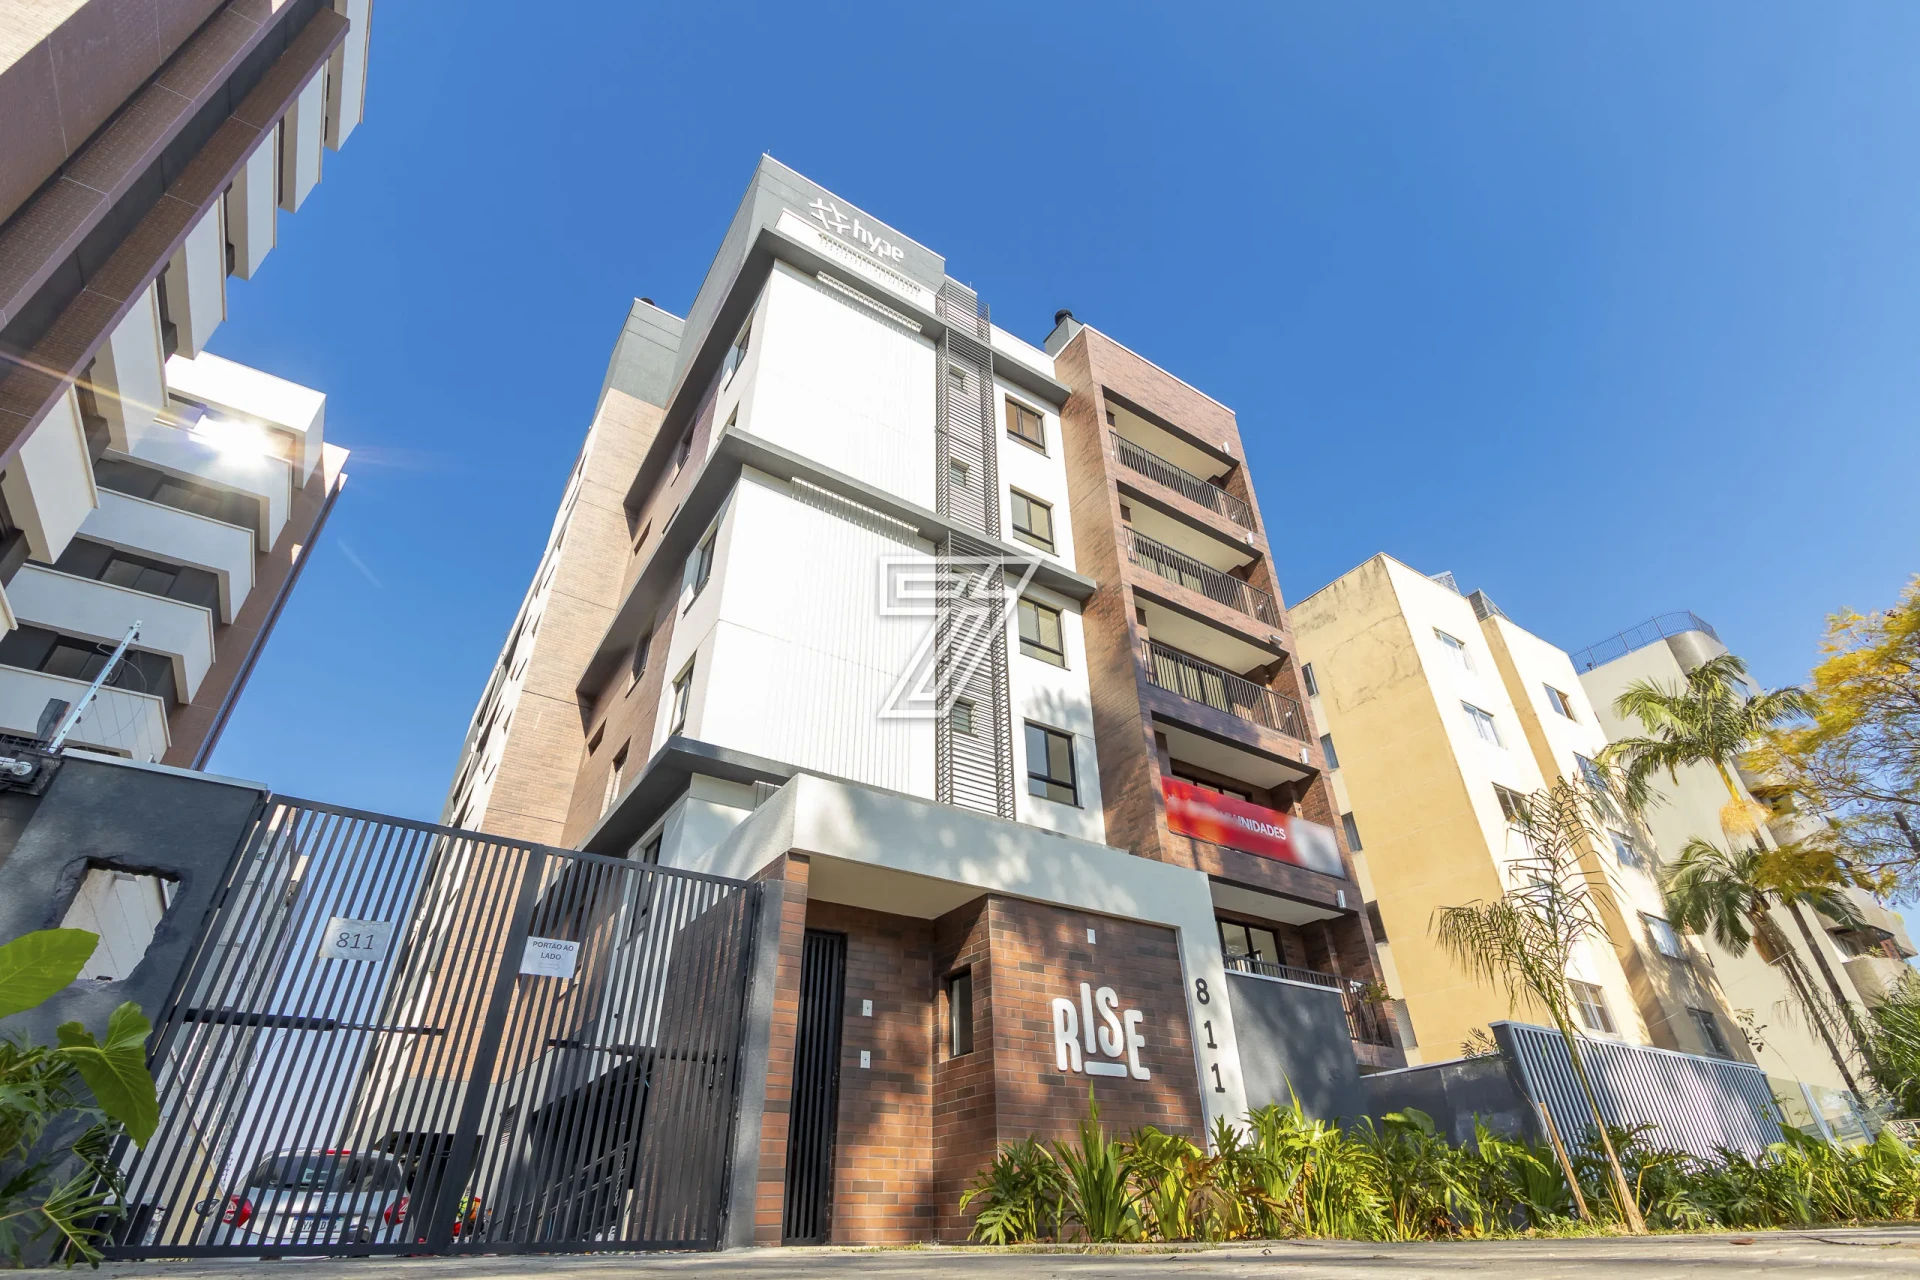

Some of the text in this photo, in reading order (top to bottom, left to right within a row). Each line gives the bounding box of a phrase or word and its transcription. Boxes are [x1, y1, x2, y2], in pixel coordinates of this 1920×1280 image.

[853, 218, 904, 263] hype
[335, 931, 374, 950] 811
[562, 944, 574, 952] AO
[540, 951, 562, 961] LADO
[1052, 982, 1151, 1081] RISE
